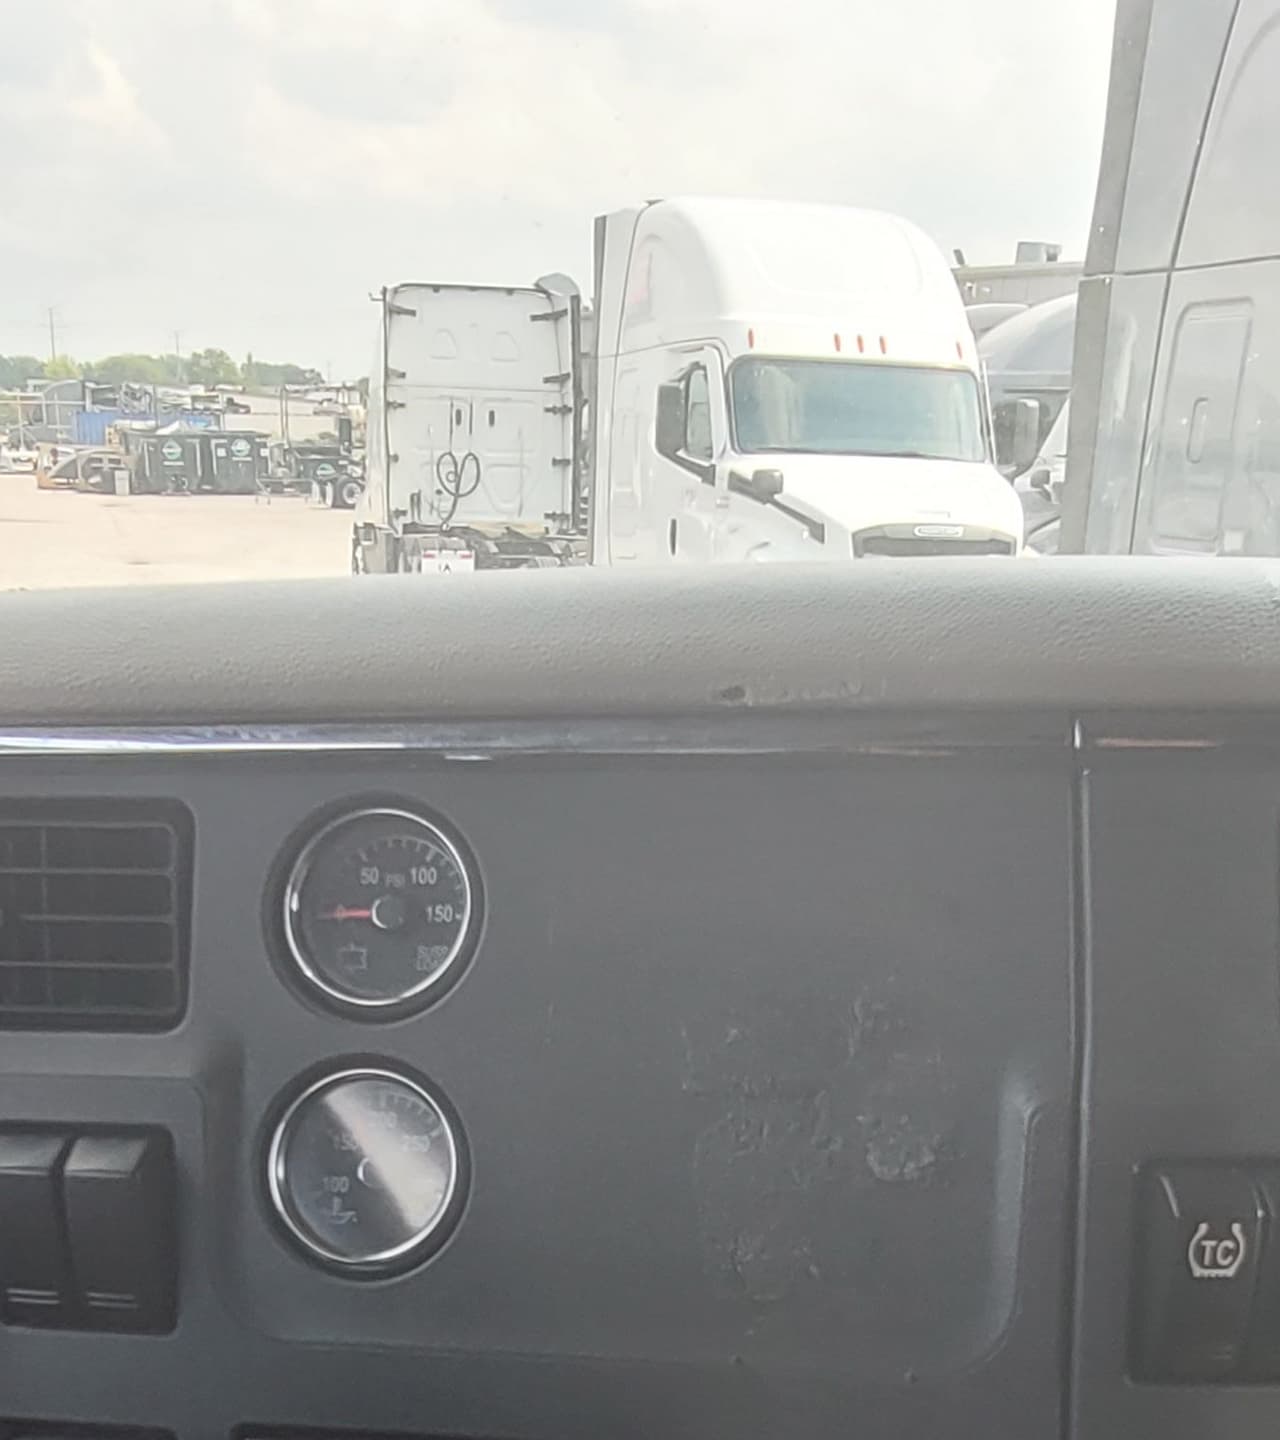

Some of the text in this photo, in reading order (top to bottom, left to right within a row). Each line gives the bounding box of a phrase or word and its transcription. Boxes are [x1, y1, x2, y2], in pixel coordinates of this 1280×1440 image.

[360, 867, 437, 887] 50 PSI 100
[426, 904, 453, 923] 150
[1200, 1240, 1236, 1266] TC
